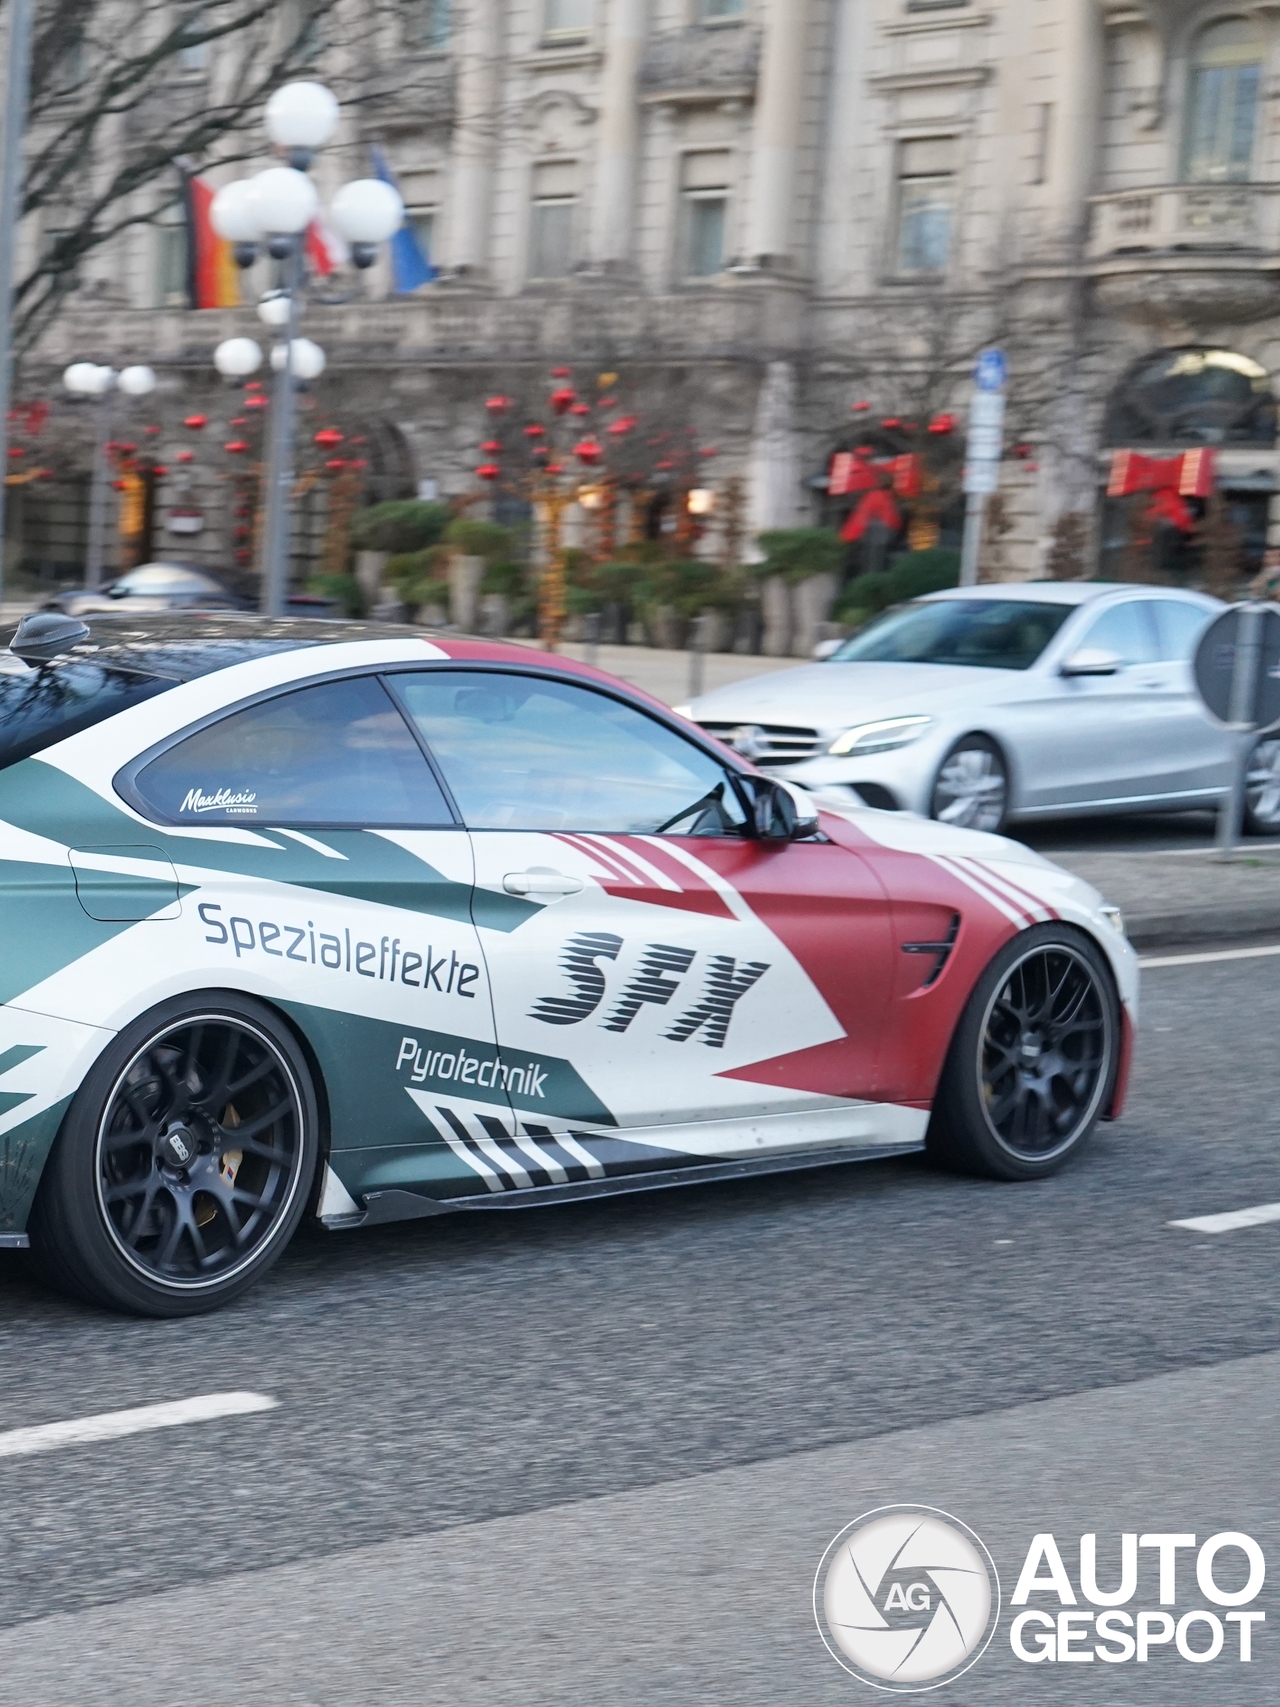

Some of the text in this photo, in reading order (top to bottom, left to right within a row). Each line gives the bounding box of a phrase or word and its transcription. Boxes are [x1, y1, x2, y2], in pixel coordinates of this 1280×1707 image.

[197, 902, 480, 999] Spezialeffekte
[524, 931, 772, 1048] SFX
[395, 1036, 549, 1099] Pyrotechnik
[169, 1133, 189, 1161] BBS
